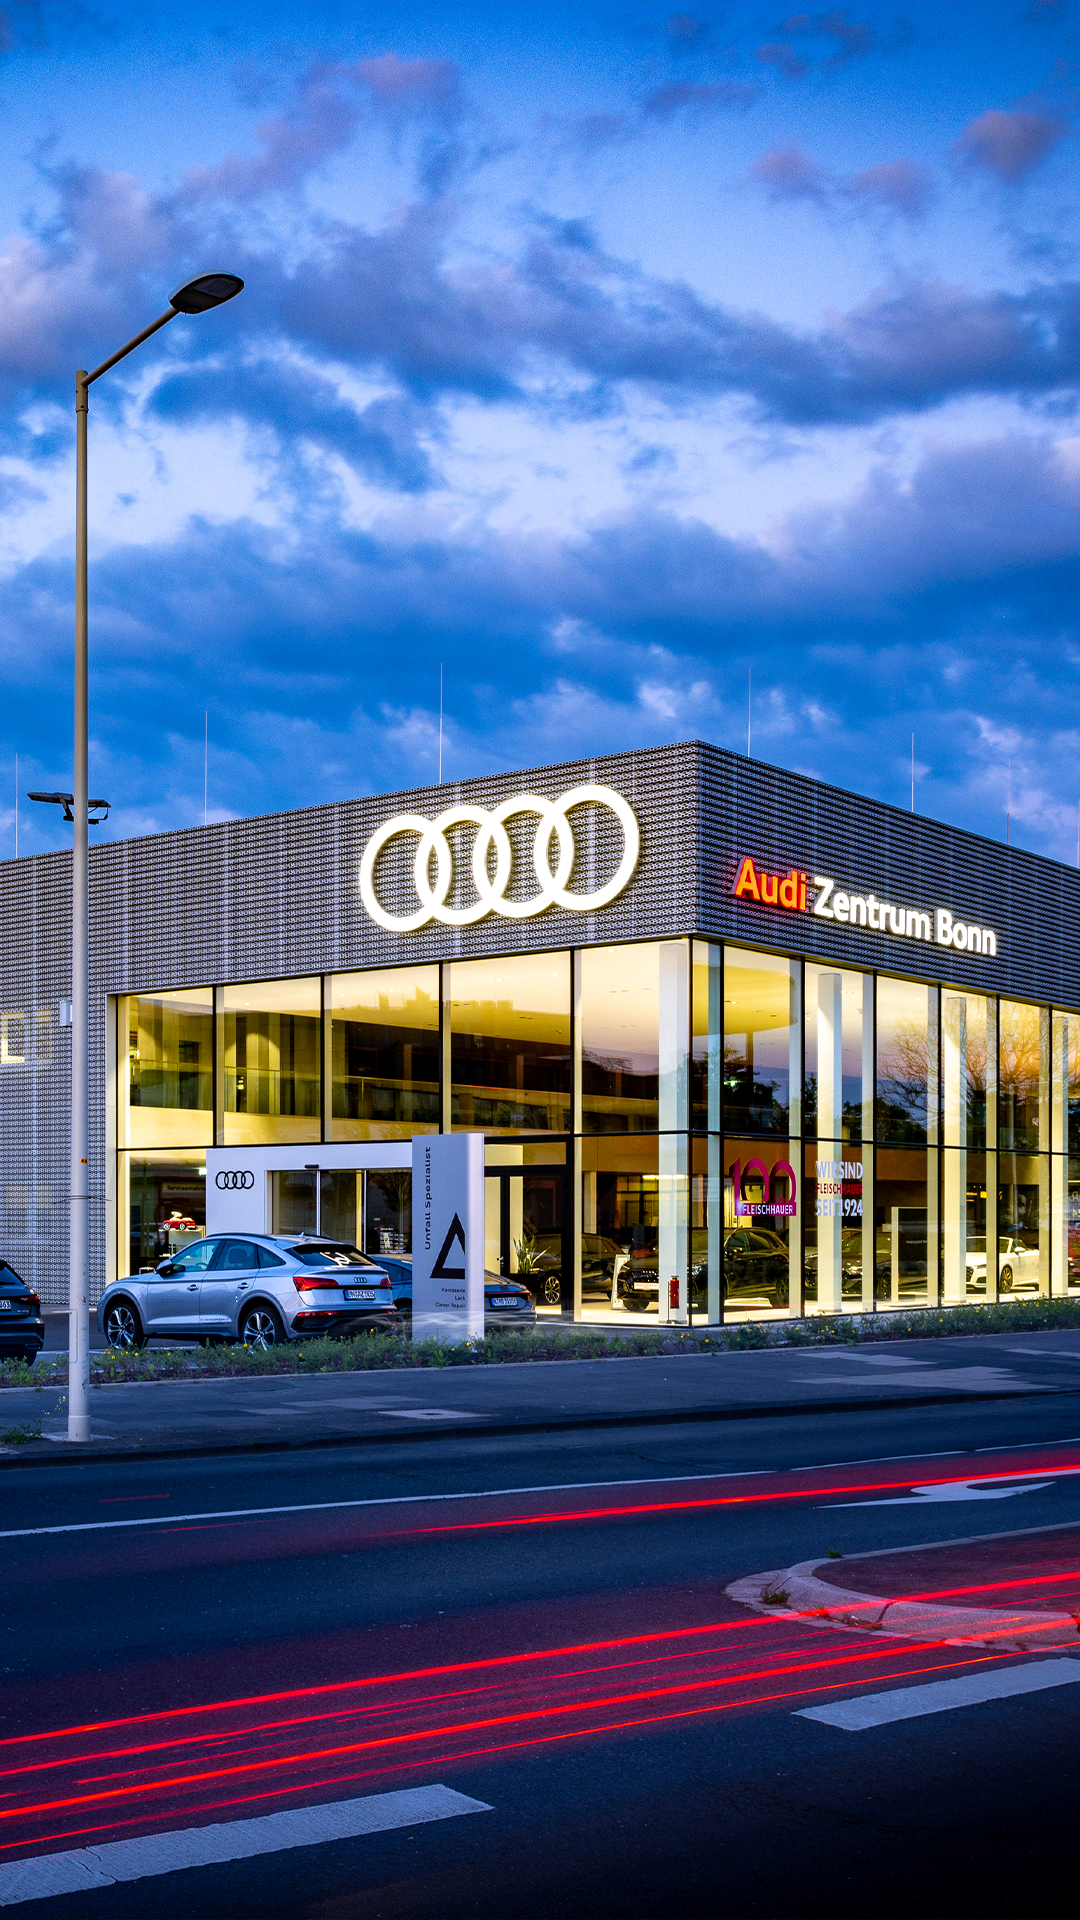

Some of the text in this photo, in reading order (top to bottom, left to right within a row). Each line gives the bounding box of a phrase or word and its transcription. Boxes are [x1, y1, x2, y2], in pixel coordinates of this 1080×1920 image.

[732, 857, 997, 956] Audi Zentrum Bonn
[424, 1146, 432, 1209] Spezialist
[815, 1160, 864, 1180] WIR SIND
[729, 1157, 797, 1212] 100
[816, 1183, 863, 1195] FLEISCHHAUER
[742, 1204, 794, 1215] FLEISCHHAUER
[815, 1198, 863, 1217] SEIT 1924
